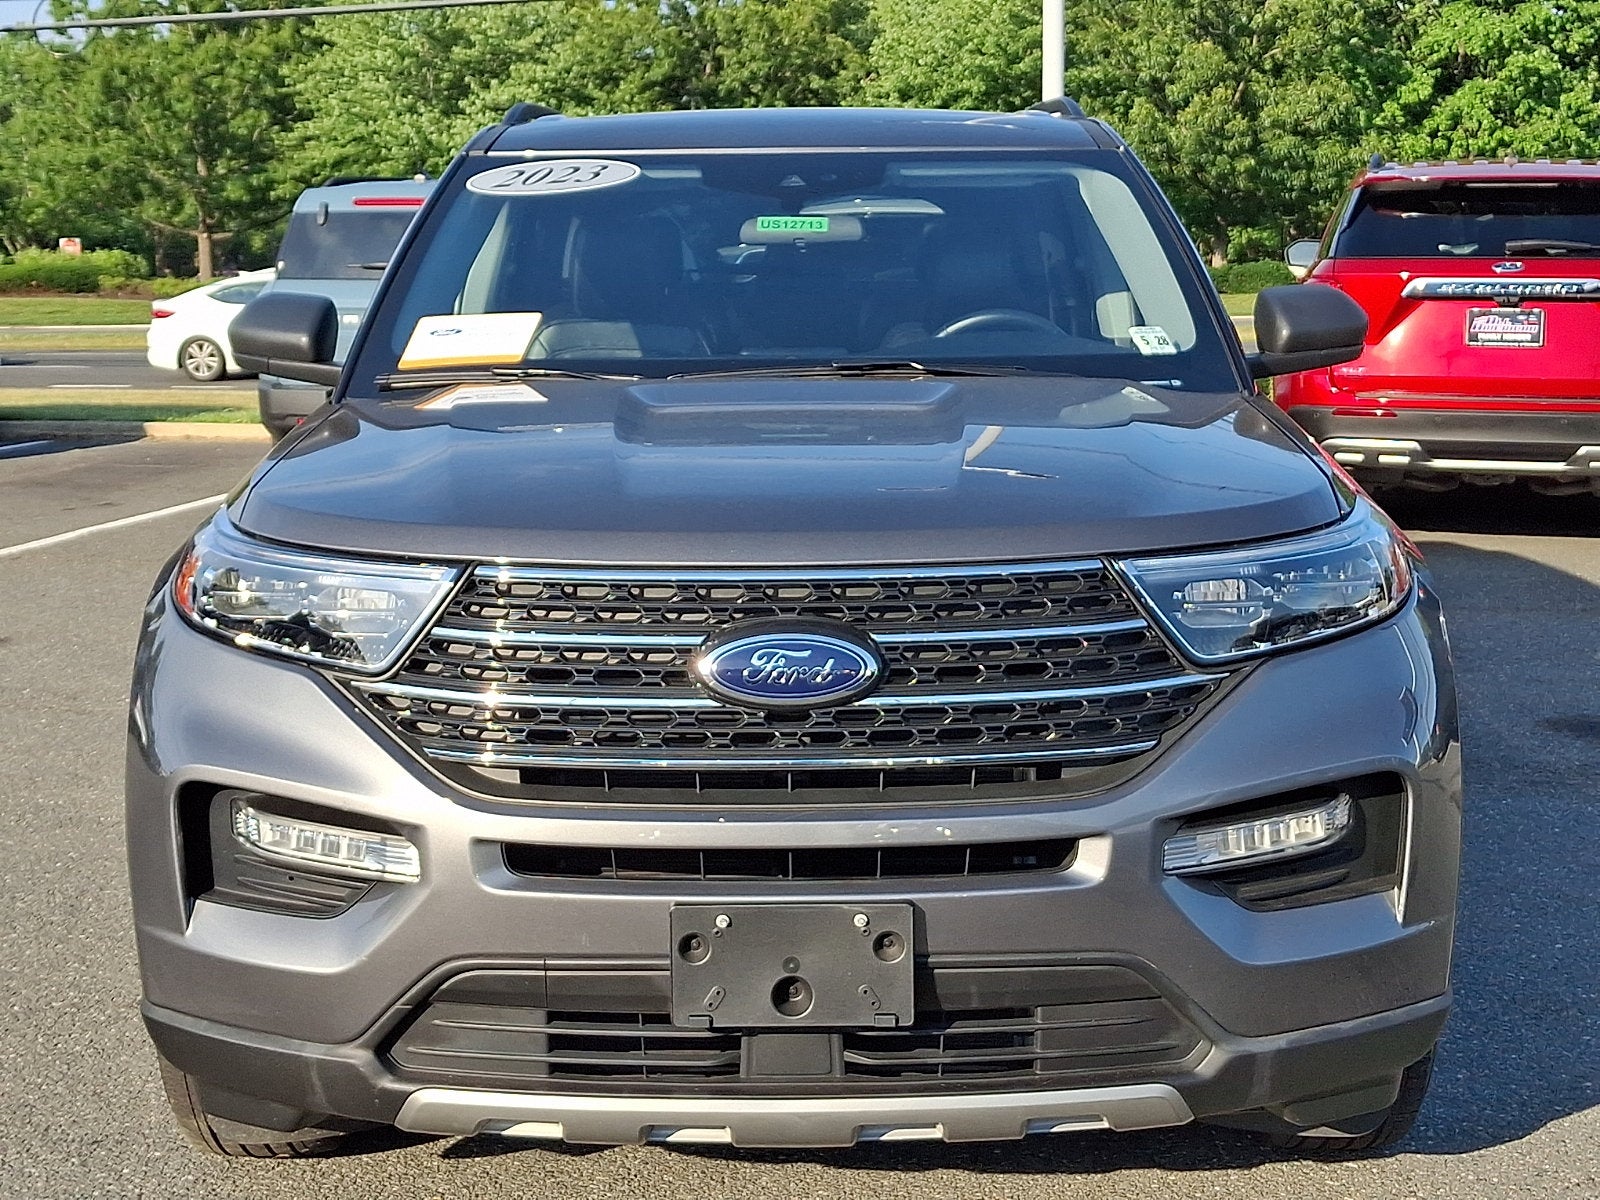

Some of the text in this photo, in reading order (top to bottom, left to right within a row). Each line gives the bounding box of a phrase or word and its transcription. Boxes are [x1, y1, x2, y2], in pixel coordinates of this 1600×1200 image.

[490, 164, 609, 188] 2023
[760, 219, 823, 230] US12713
[1139, 335, 1170, 346] 5 28
[742, 648, 835, 685] Ford
